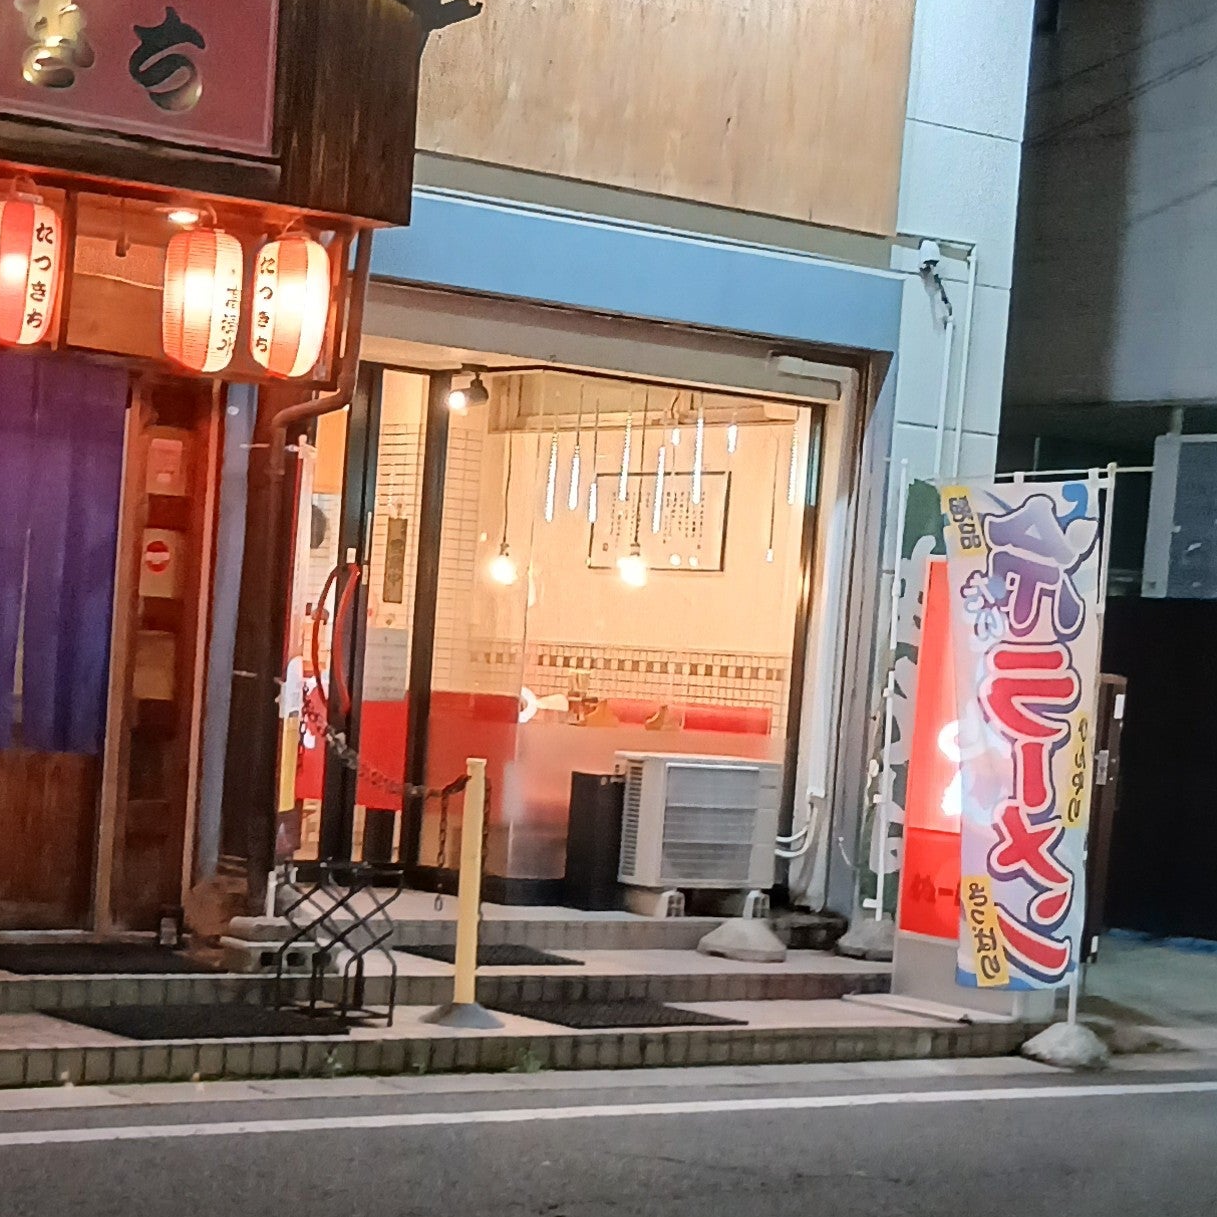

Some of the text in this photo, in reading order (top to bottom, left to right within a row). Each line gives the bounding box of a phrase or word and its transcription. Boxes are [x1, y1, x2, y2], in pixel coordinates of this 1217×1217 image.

[26, 222, 54, 329] たつきち
[255, 256, 276, 353] たつきち
